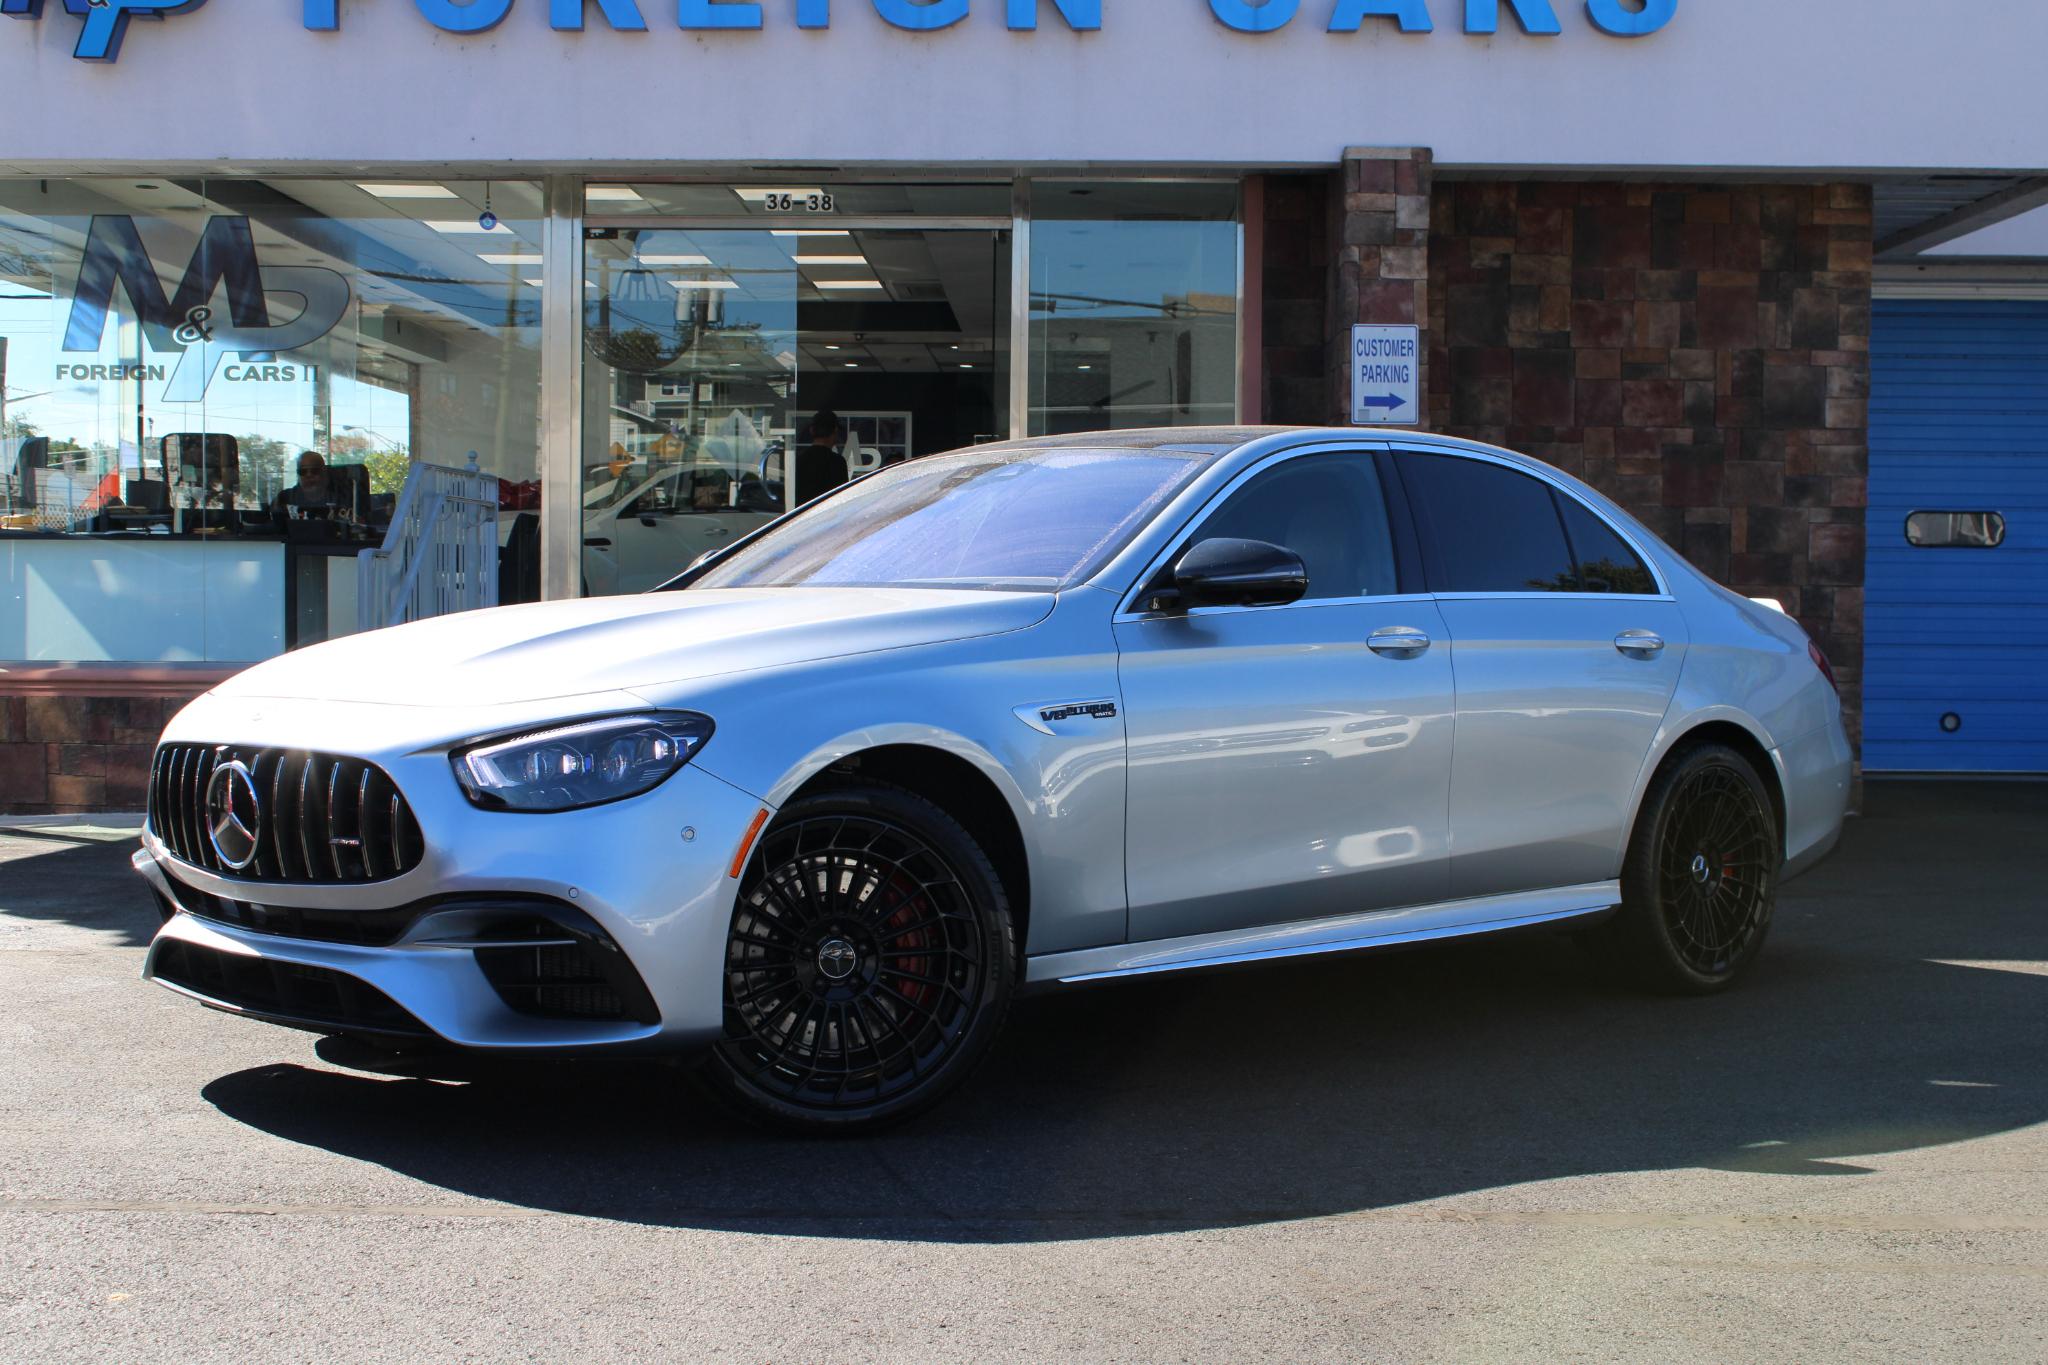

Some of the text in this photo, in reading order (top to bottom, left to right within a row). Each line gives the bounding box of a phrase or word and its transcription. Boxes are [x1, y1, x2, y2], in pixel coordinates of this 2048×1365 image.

[767, 194, 832, 210] 36-38
[1356, 339, 1414, 357] CUSTOMER
[56, 364, 164, 381] FOREIGN
[224, 365, 295, 381] CARS
[1361, 365, 1409, 383] PARKING
